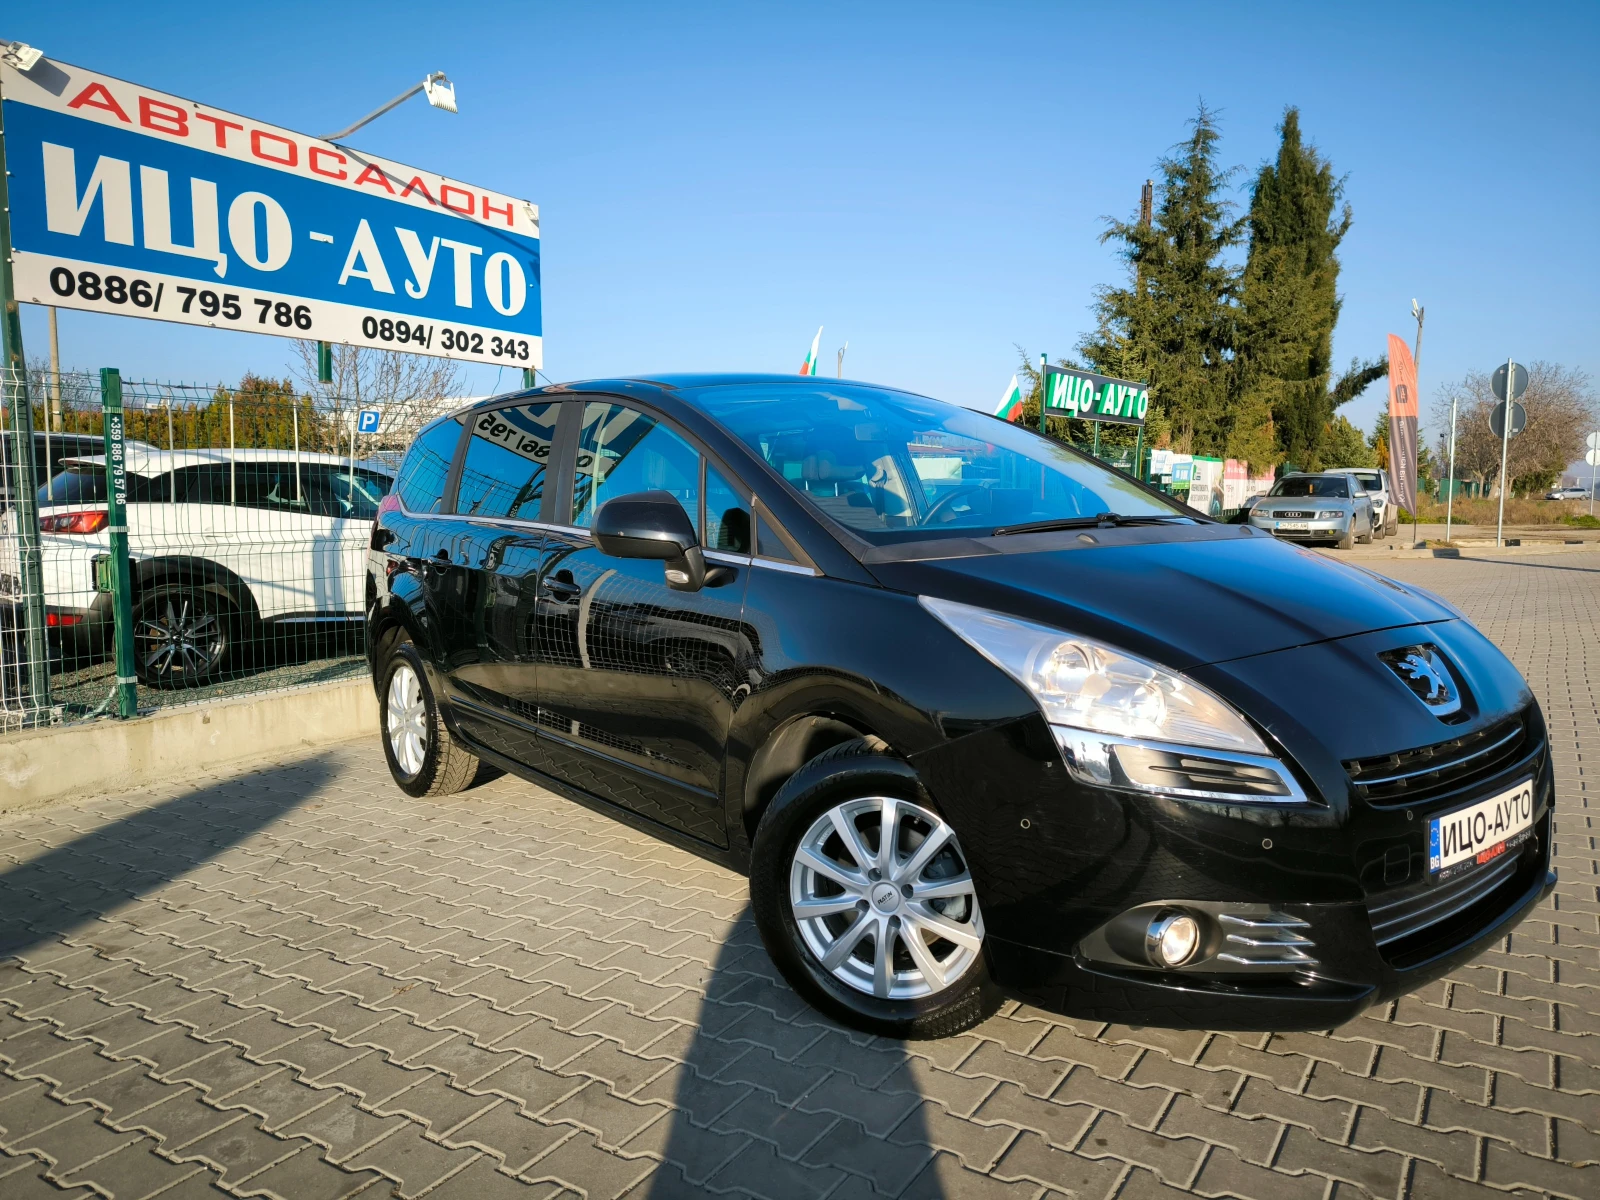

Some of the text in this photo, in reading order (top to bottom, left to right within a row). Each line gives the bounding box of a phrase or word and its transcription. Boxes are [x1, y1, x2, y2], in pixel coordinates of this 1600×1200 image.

[66, 81, 514, 227] АВТОСАЛОН
[50, 267, 312, 330] 0886/ 795 786
[362, 316, 530, 361] 0894/ 302 343
[362, 412, 376, 430] P
[1051, 373, 1149, 419] ИЦО-АУТО
[111, 416, 126, 505] +359 886 79 57 86
[1443, 789, 1531, 858] ИЦО-АУТО
[1430, 855, 1440, 870] BG
